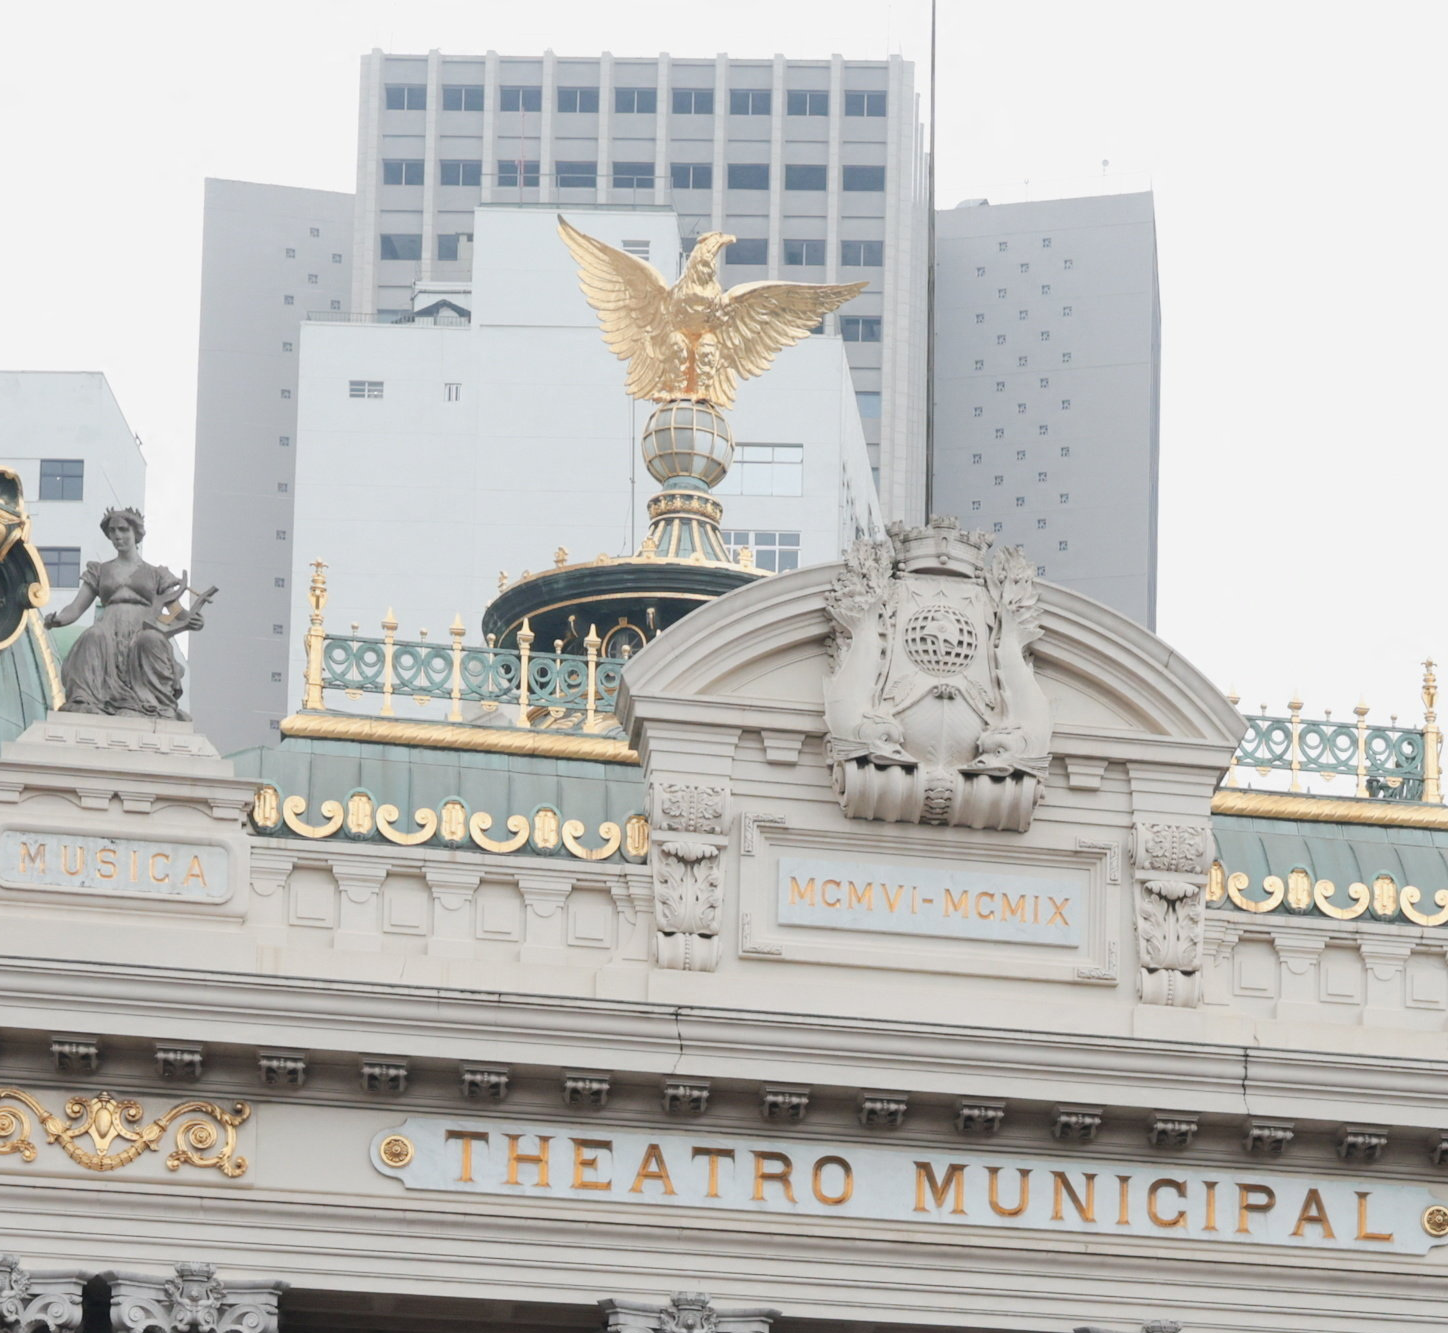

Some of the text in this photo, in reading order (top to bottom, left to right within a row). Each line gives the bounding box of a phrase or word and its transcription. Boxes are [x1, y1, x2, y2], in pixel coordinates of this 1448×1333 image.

[19, 841, 207, 888] MUSICA
[444, 1129, 1394, 1245] THEATRO MUNICIPAL
